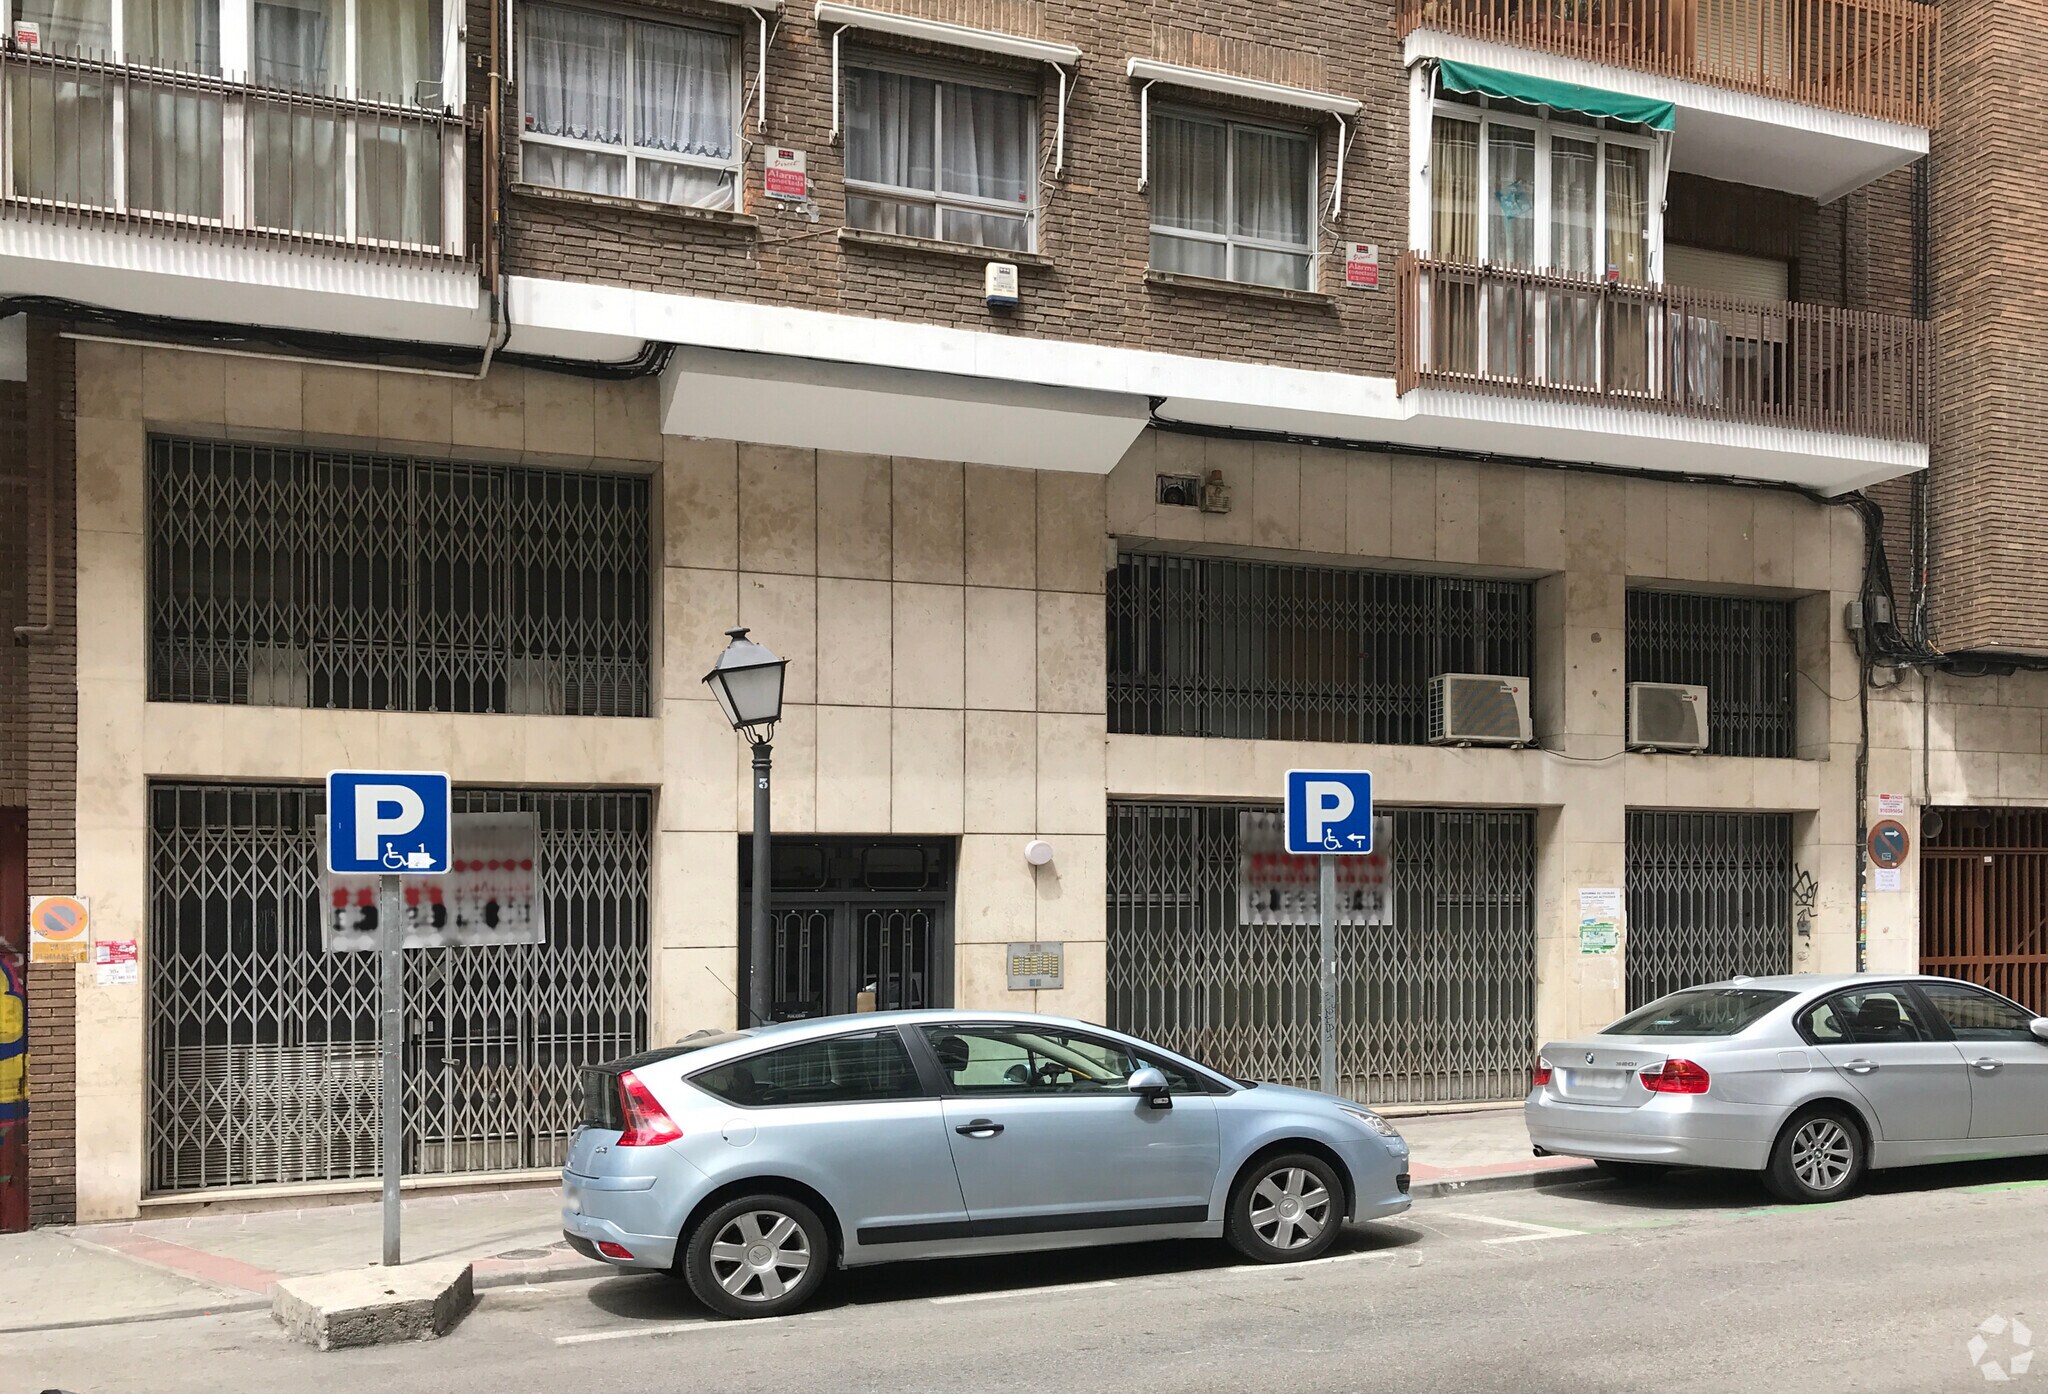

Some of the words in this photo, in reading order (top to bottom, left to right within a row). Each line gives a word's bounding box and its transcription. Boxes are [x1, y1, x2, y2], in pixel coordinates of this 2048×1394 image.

[767, 169, 804, 182] Alarma
[767, 177, 804, 187] conectada
[1348, 262, 1378, 273] Alarma
[758, 777, 769, 789] 3
[1305, 781, 1355, 843] P
[354, 784, 425, 861] P
[418, 843, 425, 853] 1
[1356, 840, 1362, 849] 1
